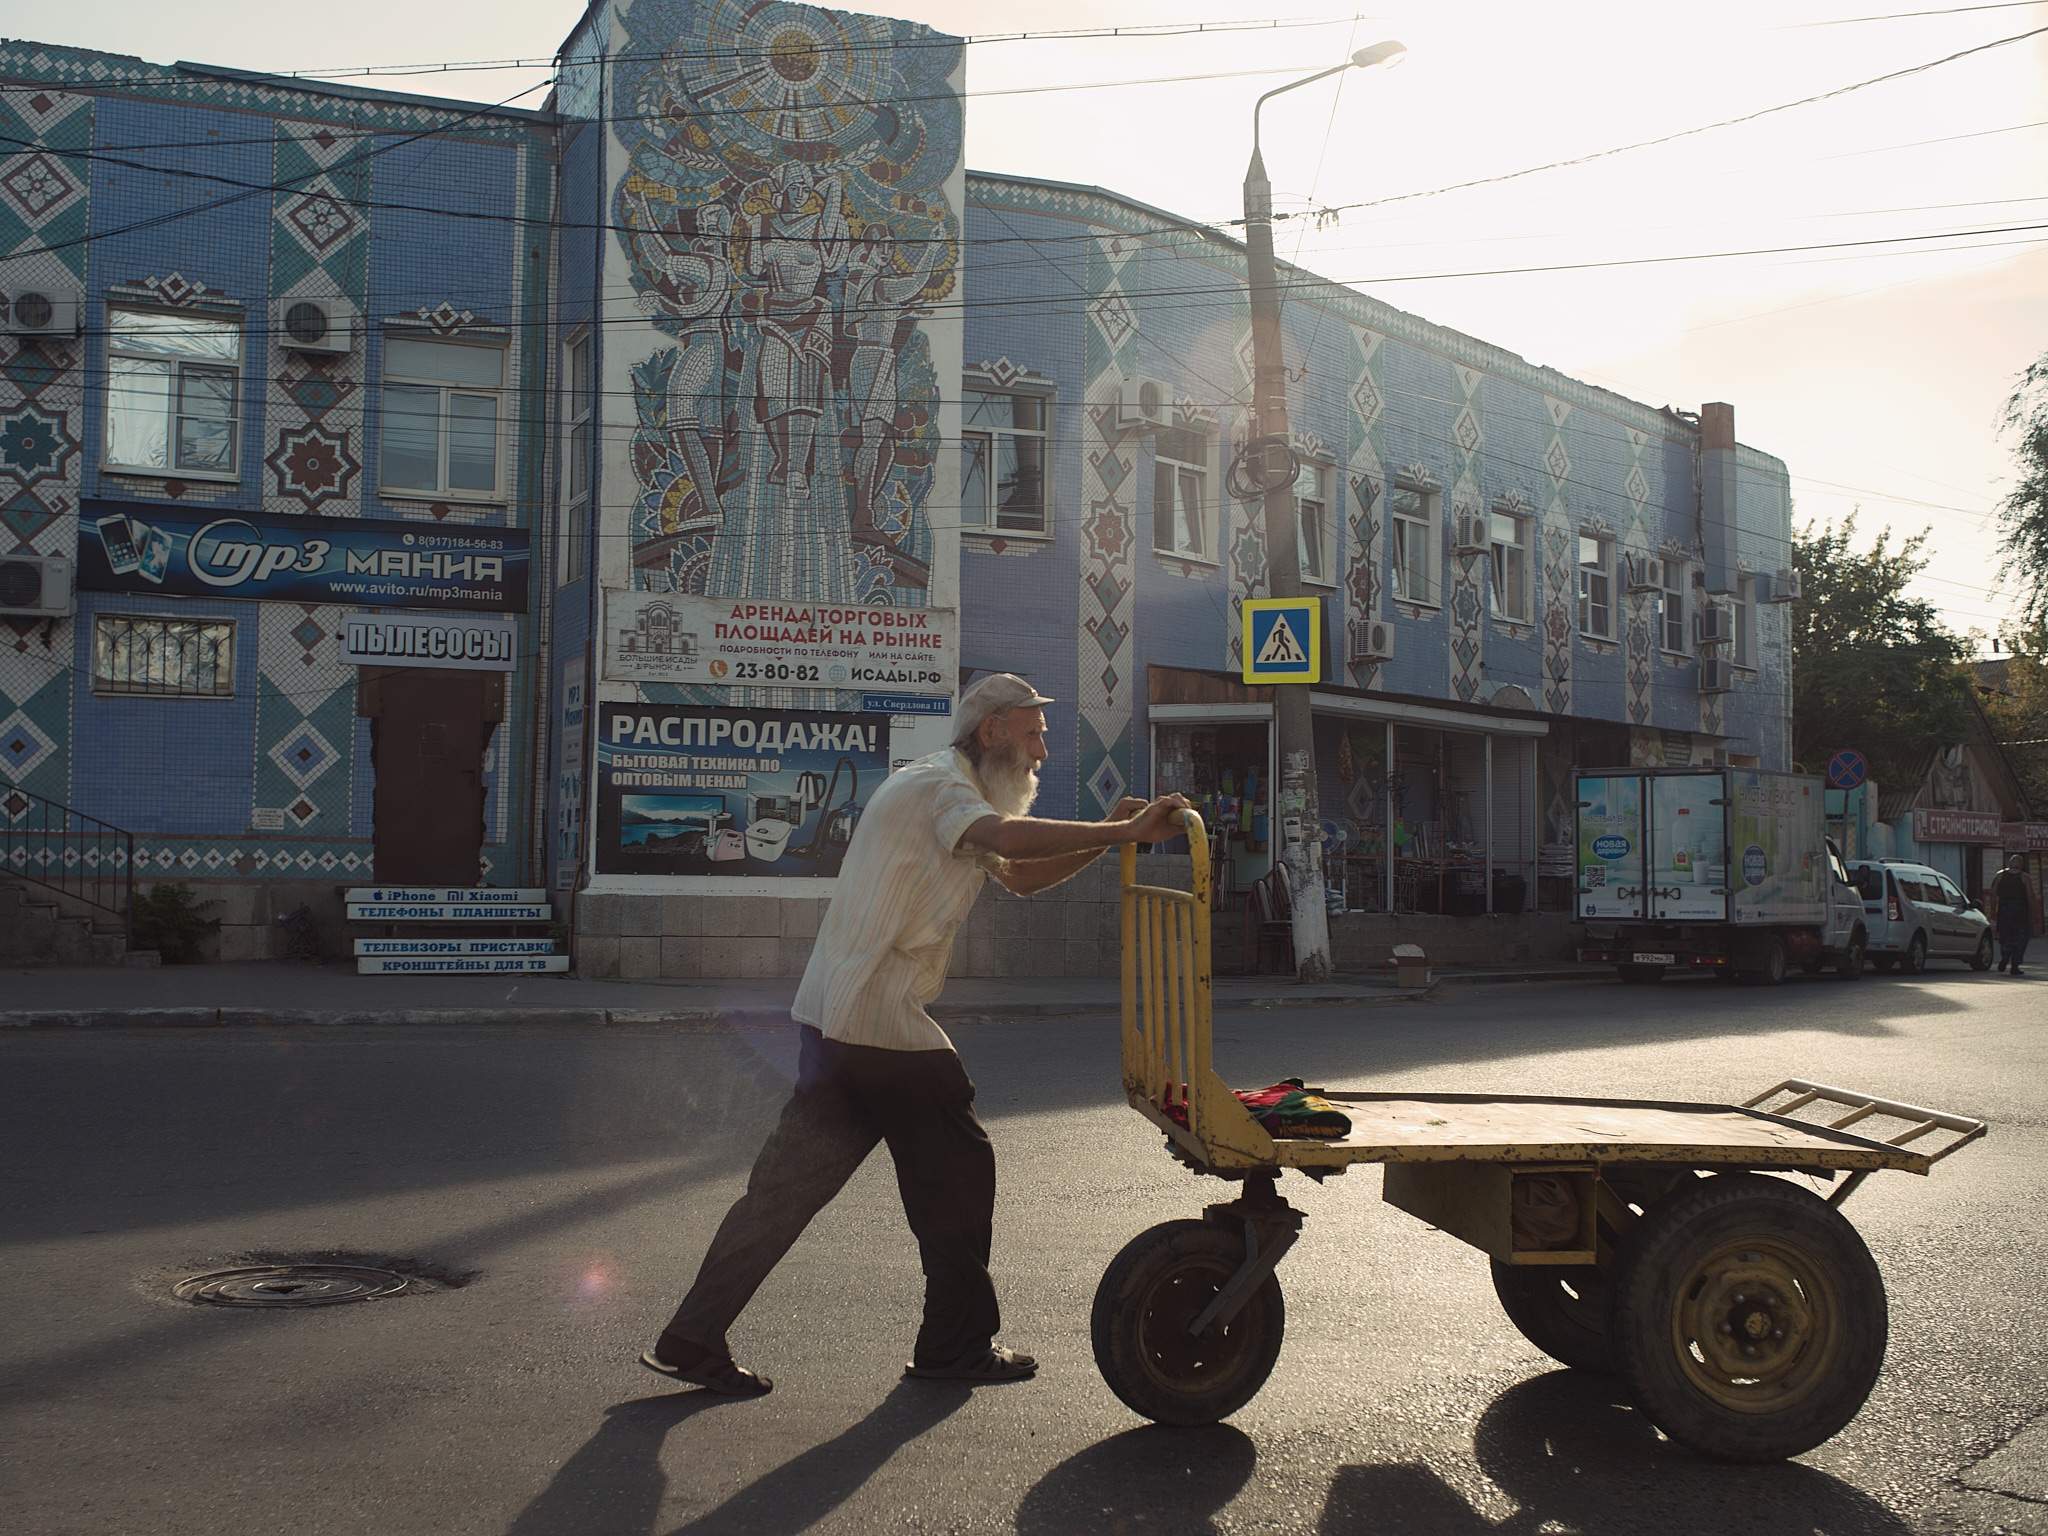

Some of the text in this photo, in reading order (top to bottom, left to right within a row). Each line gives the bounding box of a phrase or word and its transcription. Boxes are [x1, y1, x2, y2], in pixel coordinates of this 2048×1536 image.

[418, 534, 504, 550] 8(917)184-56-83
[202, 533, 331, 586] mp3
[329, 582, 503, 601] www.avito.ru/mp3mania
[730, 604, 928, 629] АРЕНДА ТОРГОВЫХ
[347, 622, 511, 662] ПЫЛЕСОСЫ
[715, 623, 942, 649] ПЛОЩАДЕЙ НА РЫНКЕ
[619, 654, 698, 664] БОЛЬШИЕ ИСАДЫ
[719, 645, 936, 662] ПОДРОБНОСТИ ПО ТЕЛЕФОНУ ИЛИ НА САЙТЕ:
[735, 661, 819, 682] 23-80-82
[850, 666, 942, 684] ИСАДЫ.РФ
[867, 700, 881, 709] ул.
[883, 699, 931, 710] Свердлова
[611, 714, 877, 754] РАСПРОДАЖА!
[611, 754, 780, 772] БЫТОВАЯ ТЕХНИКА ПО
[612, 772, 747, 790] ОПТОВЫМ ЦЕНАМ
[388, 891, 436, 901] iPhone
[469, 891, 518, 901] Xiaomi
[359, 907, 541, 918] ТЕЛЕФОНЫ ПЛАНШЕТЫ
[363, 942, 554, 954] ТЕЛЕВИЗОРЫ ПРИСТАВКИ
[383, 959, 546, 972] КРОНШТЕЙНЫ ДЛЯ ТВ
